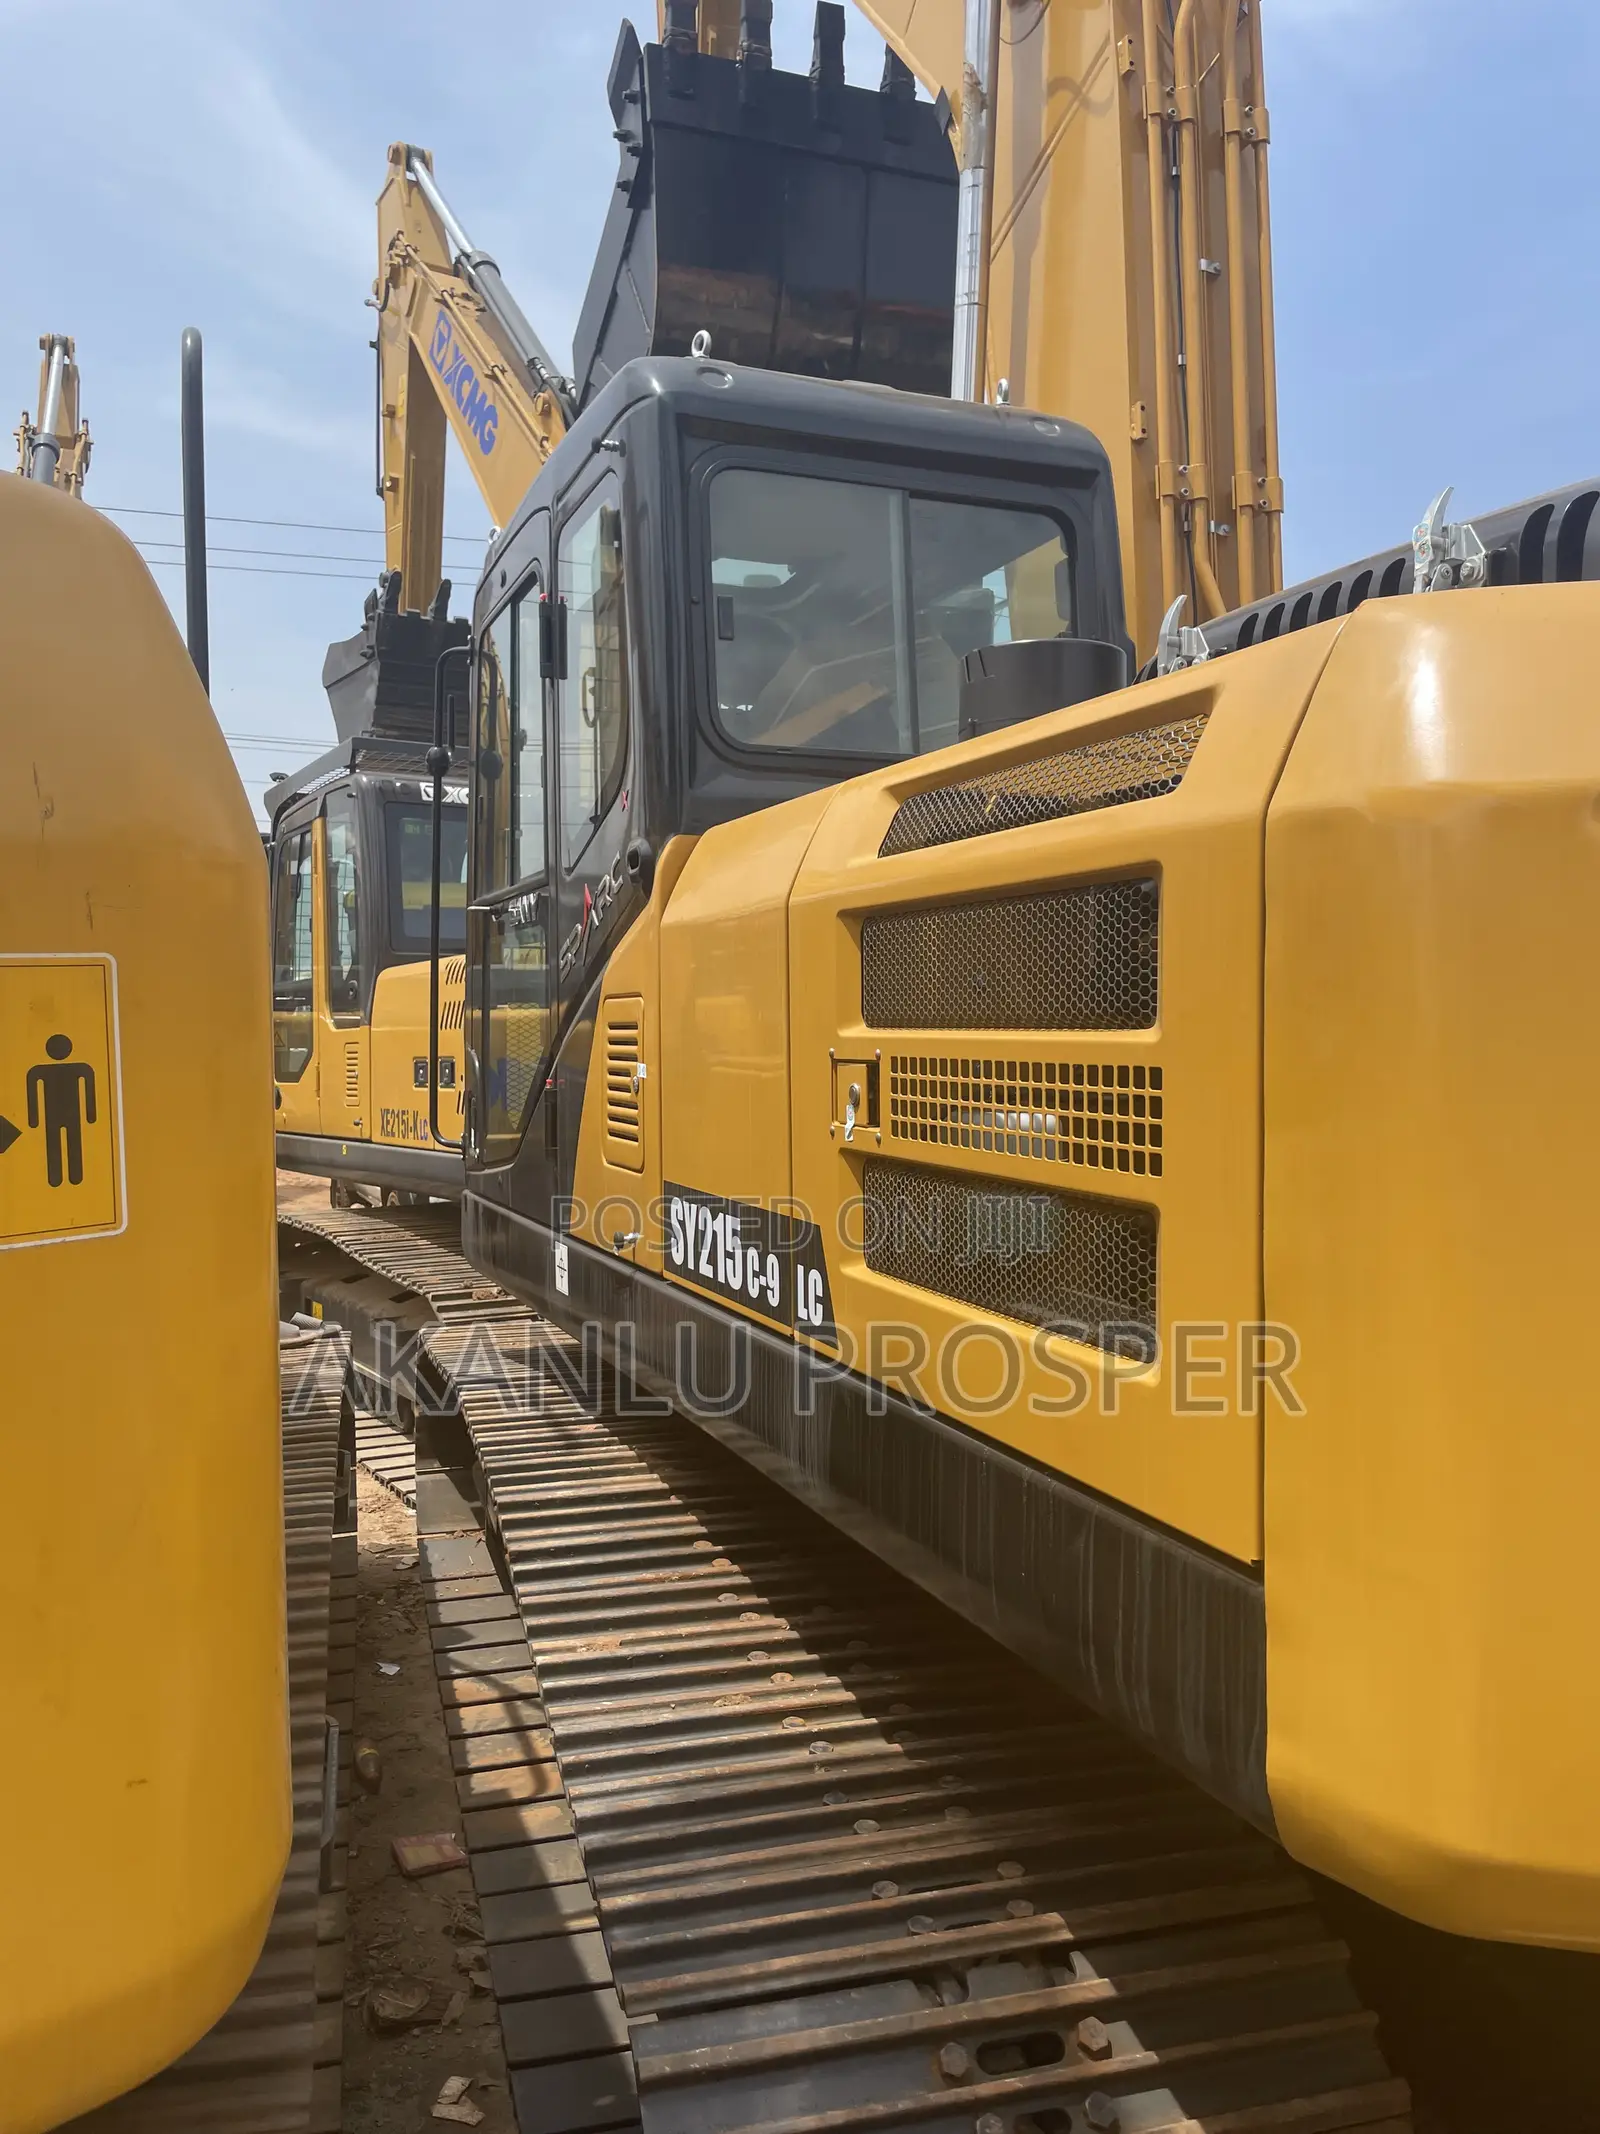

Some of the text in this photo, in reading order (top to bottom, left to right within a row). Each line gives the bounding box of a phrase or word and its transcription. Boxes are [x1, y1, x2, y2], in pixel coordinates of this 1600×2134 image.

[443, 340, 498, 456] XCMG
[441, 784, 470, 805] XC
[797, 1264, 824, 1327] LC
